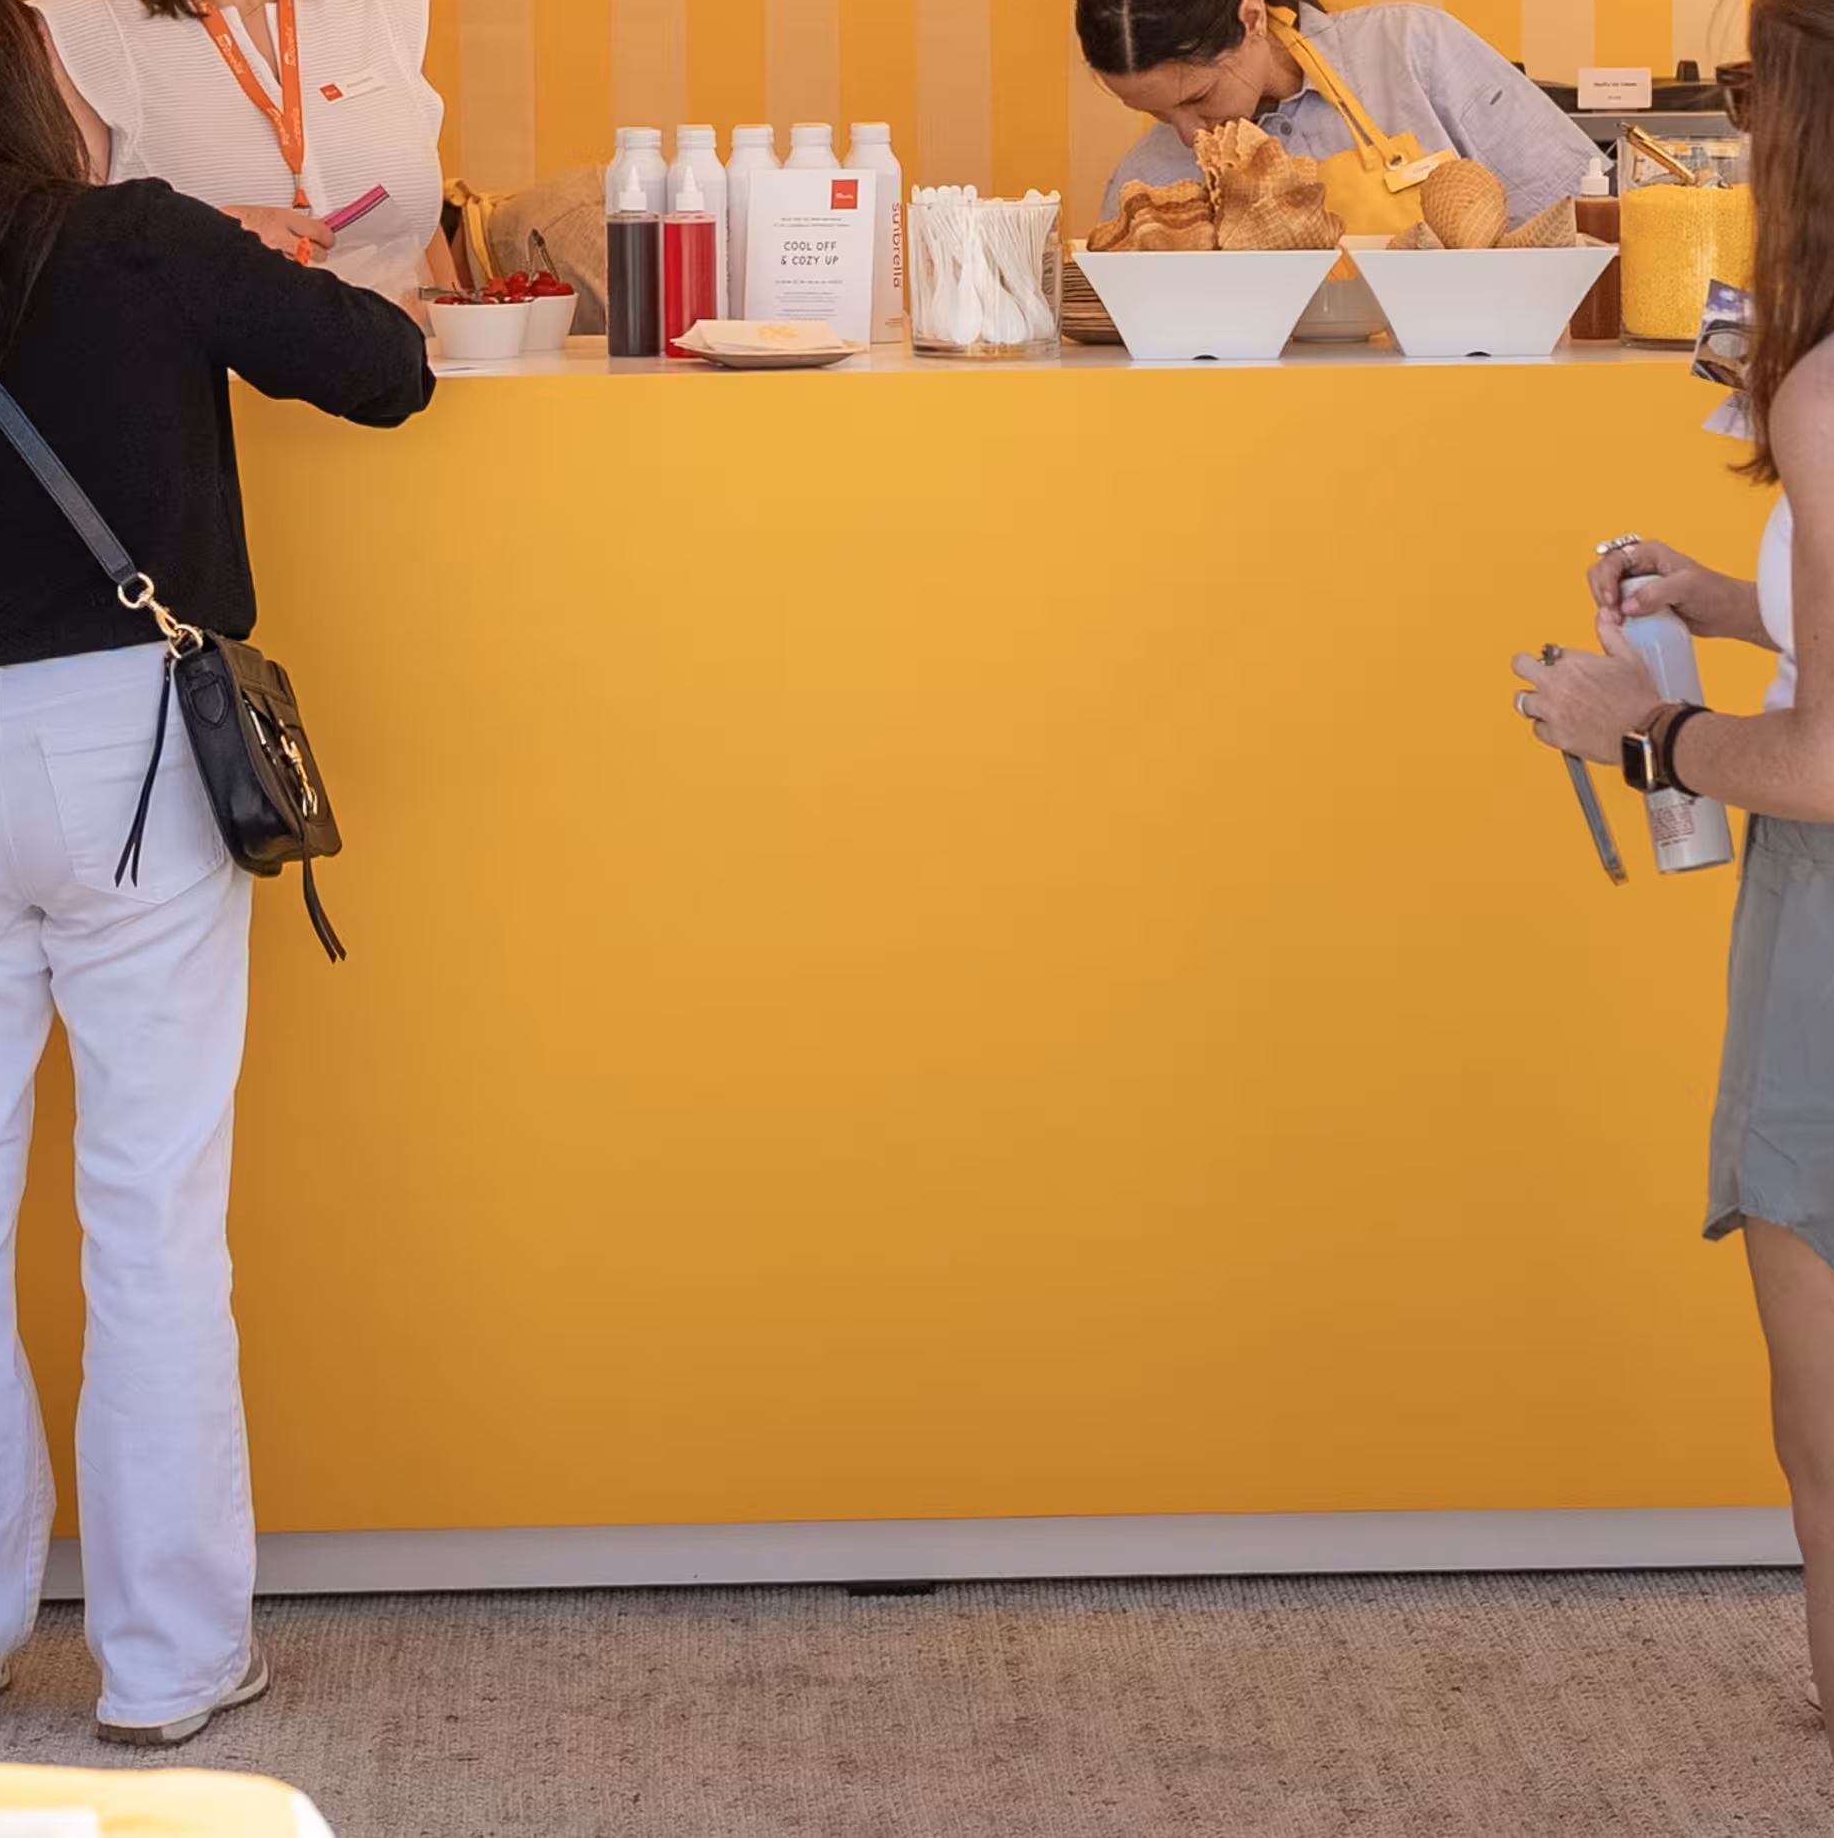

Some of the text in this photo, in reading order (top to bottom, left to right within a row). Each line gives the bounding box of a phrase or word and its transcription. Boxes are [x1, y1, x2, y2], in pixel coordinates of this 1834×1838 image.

[783, 241, 838, 252] COOL OFF
[791, 255, 821, 266] COZY
[824, 255, 840, 266] UP
